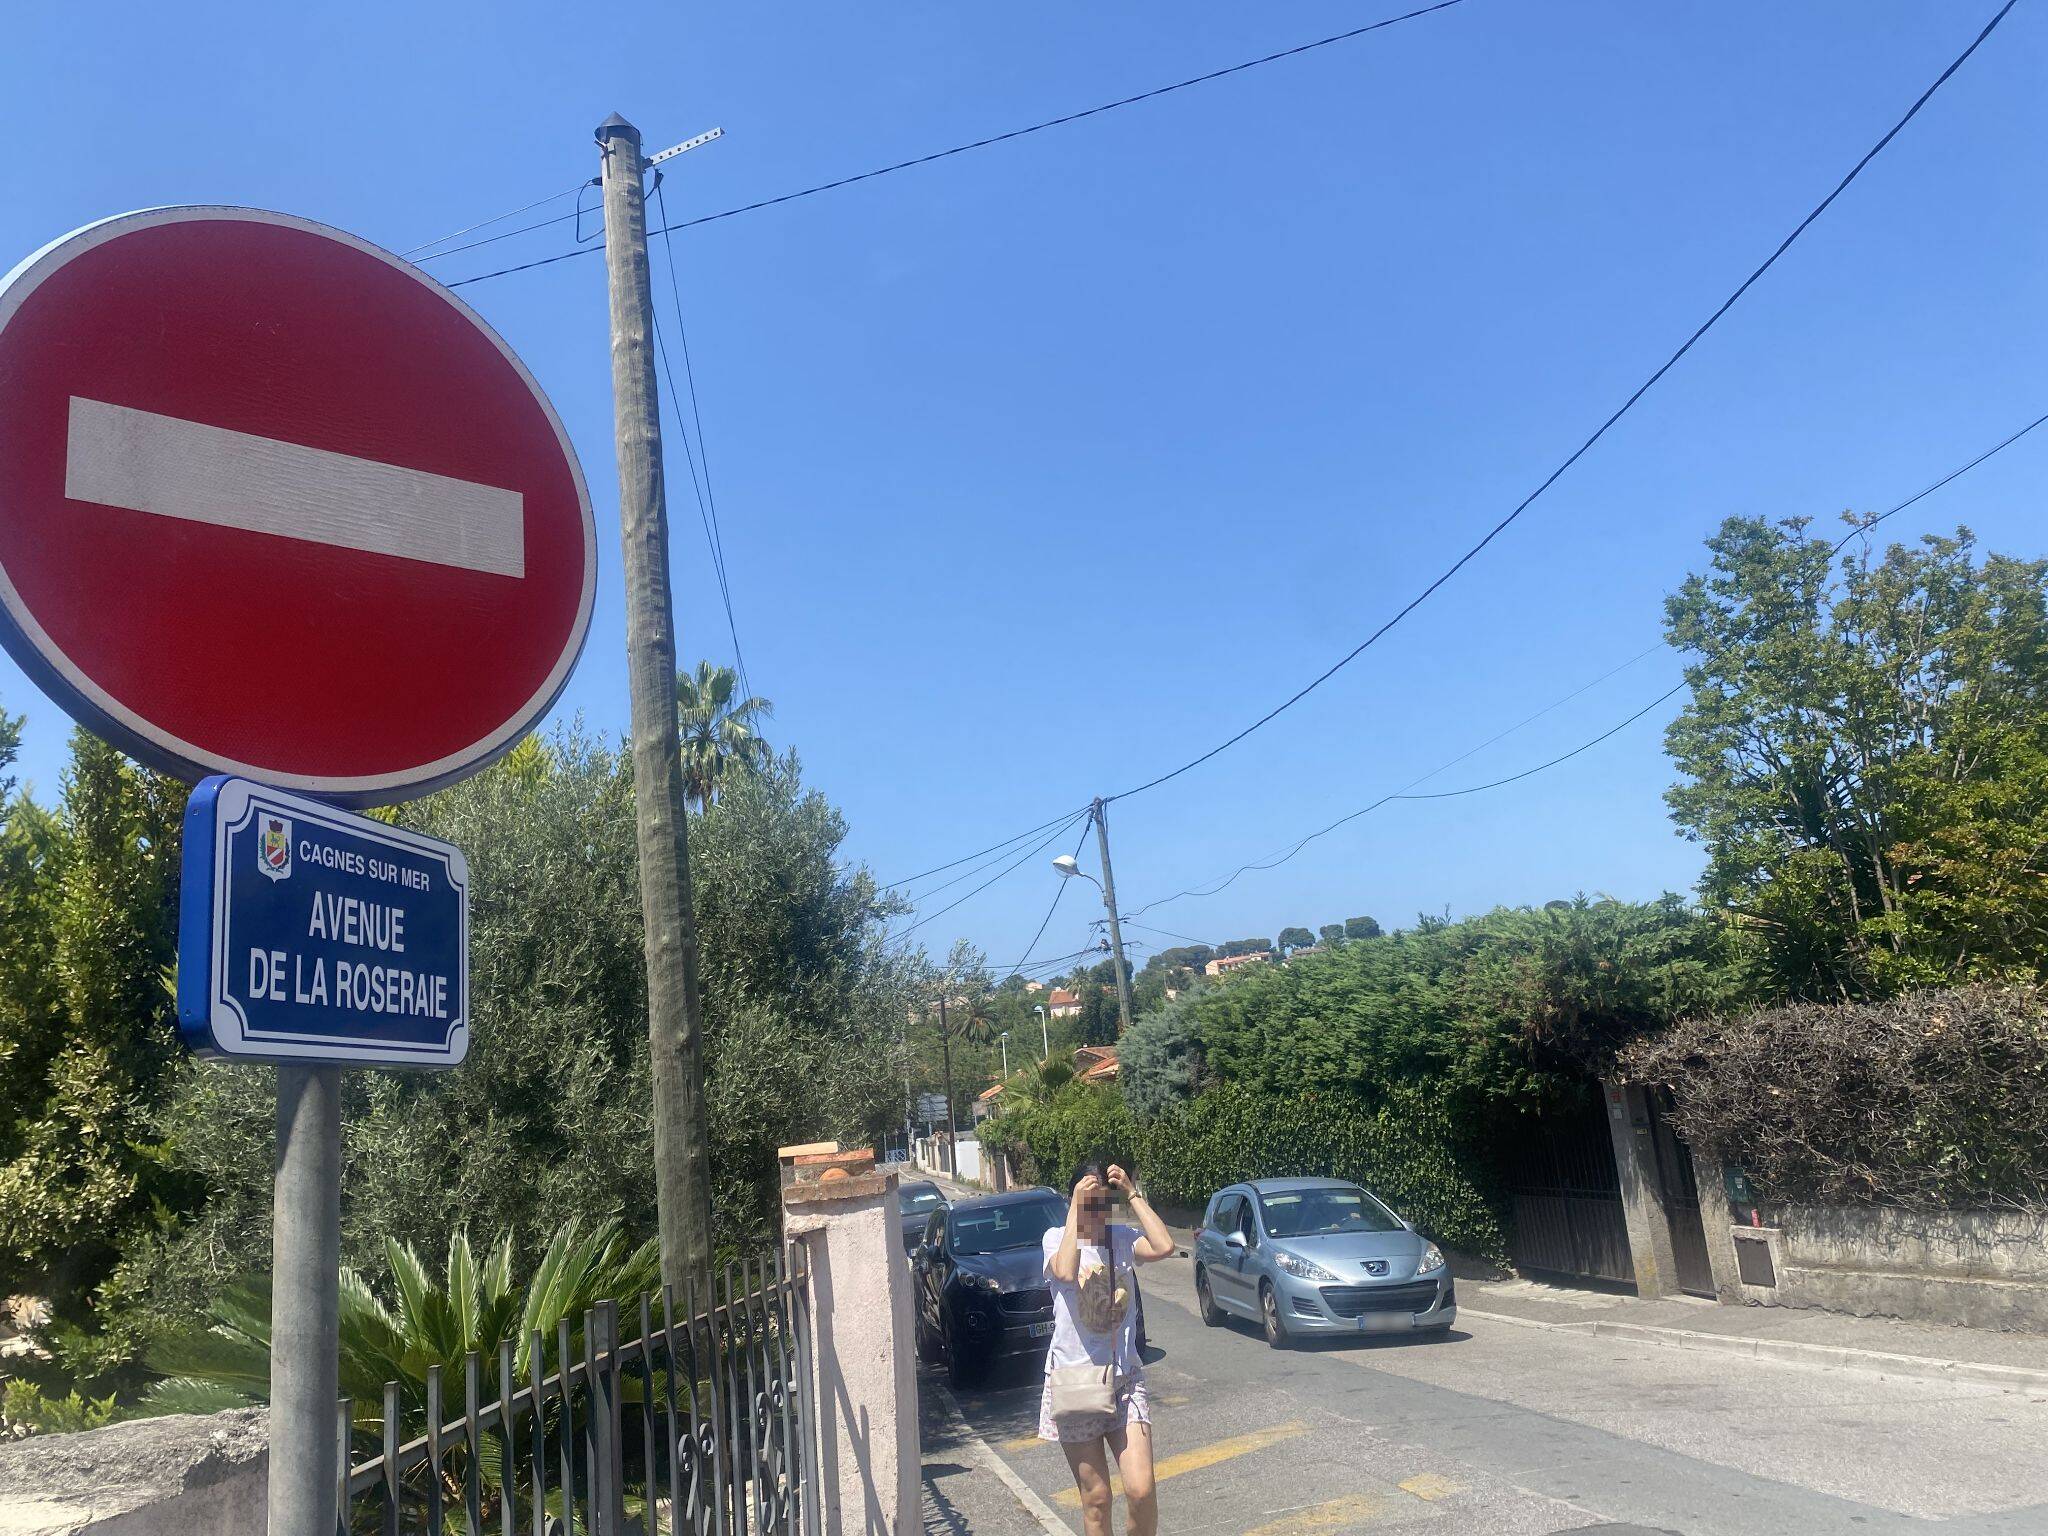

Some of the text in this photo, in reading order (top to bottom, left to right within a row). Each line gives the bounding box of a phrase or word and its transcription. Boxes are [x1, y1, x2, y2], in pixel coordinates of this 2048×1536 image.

[300, 840, 430, 892] CAGNES SUR MER
[308, 890, 405, 953] AVENUE
[249, 947, 447, 1019] DE LA ROSERAIE
